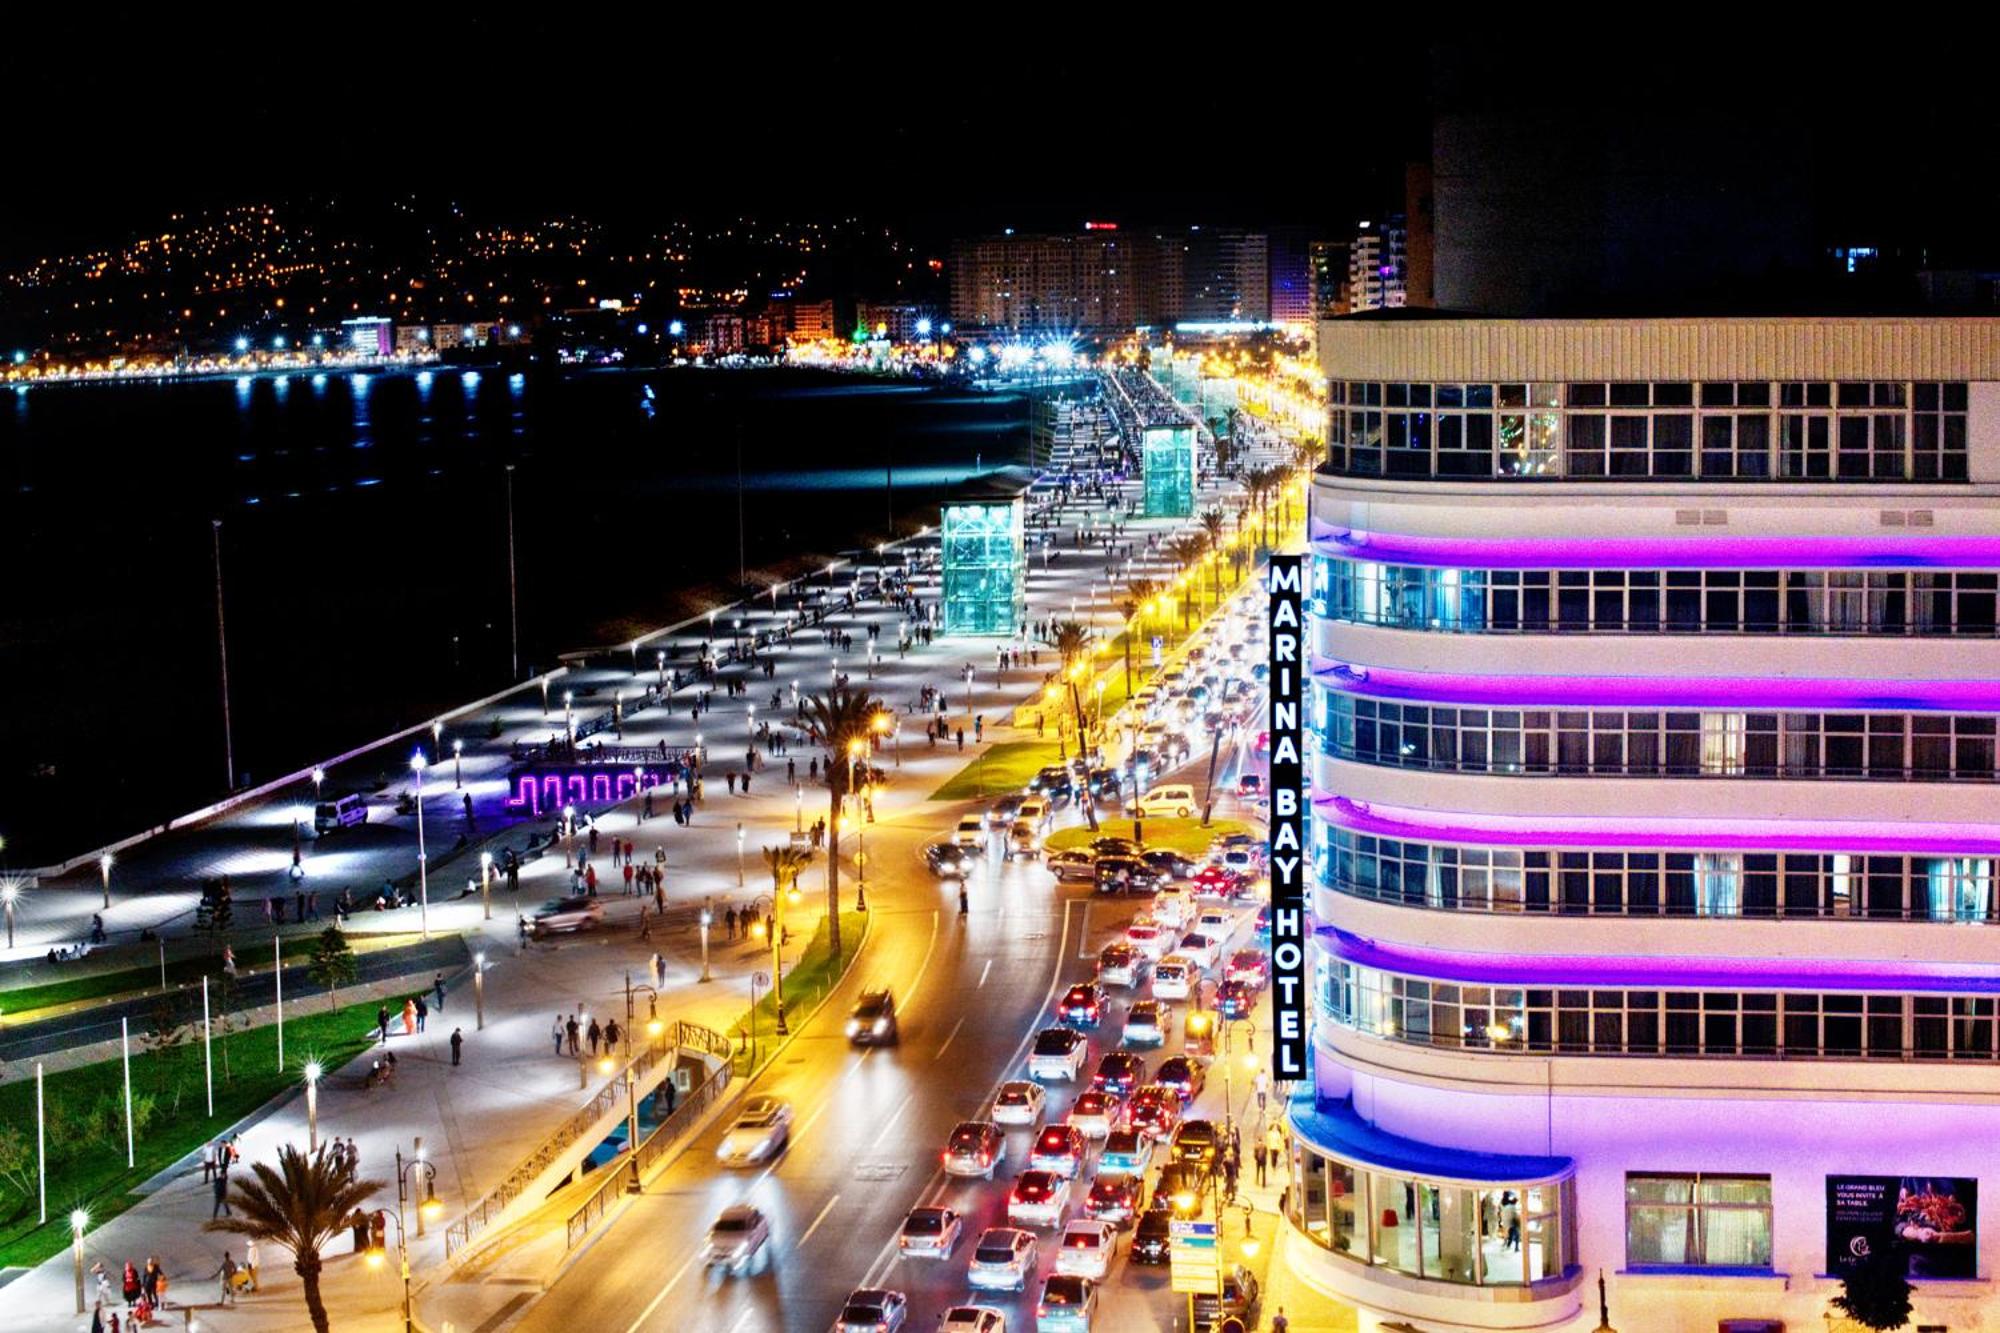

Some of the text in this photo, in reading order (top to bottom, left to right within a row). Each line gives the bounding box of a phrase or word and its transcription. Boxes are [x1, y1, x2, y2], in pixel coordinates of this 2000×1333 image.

[1270, 565, 1301, 1072] MARINA BAY HOTEL
